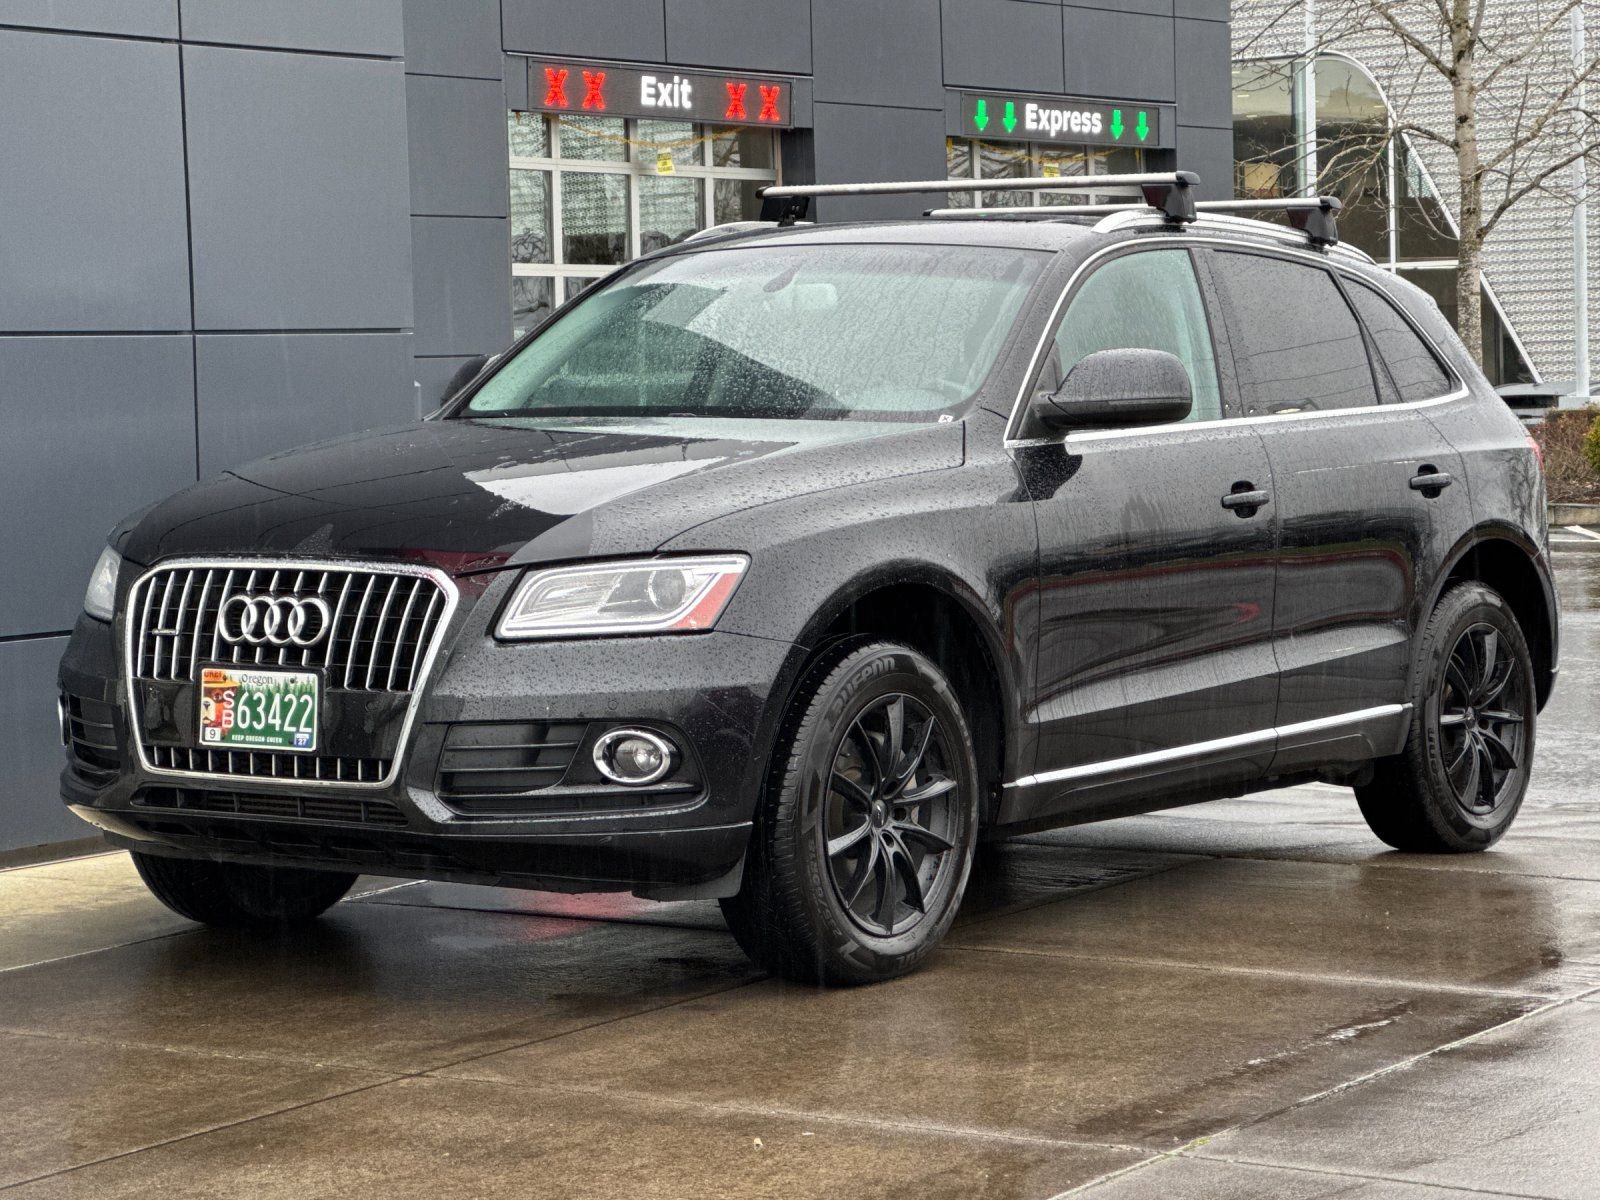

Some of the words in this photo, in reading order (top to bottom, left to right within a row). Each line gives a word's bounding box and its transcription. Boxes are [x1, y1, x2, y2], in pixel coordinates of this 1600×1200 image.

[640, 75, 692, 109] Exit
[1025, 103, 1103, 137] Express
[241, 673, 273, 687] Oregon
[236, 690, 314, 733] 63422
[209, 728, 216, 739] 9
[297, 738, 307, 746] 27
